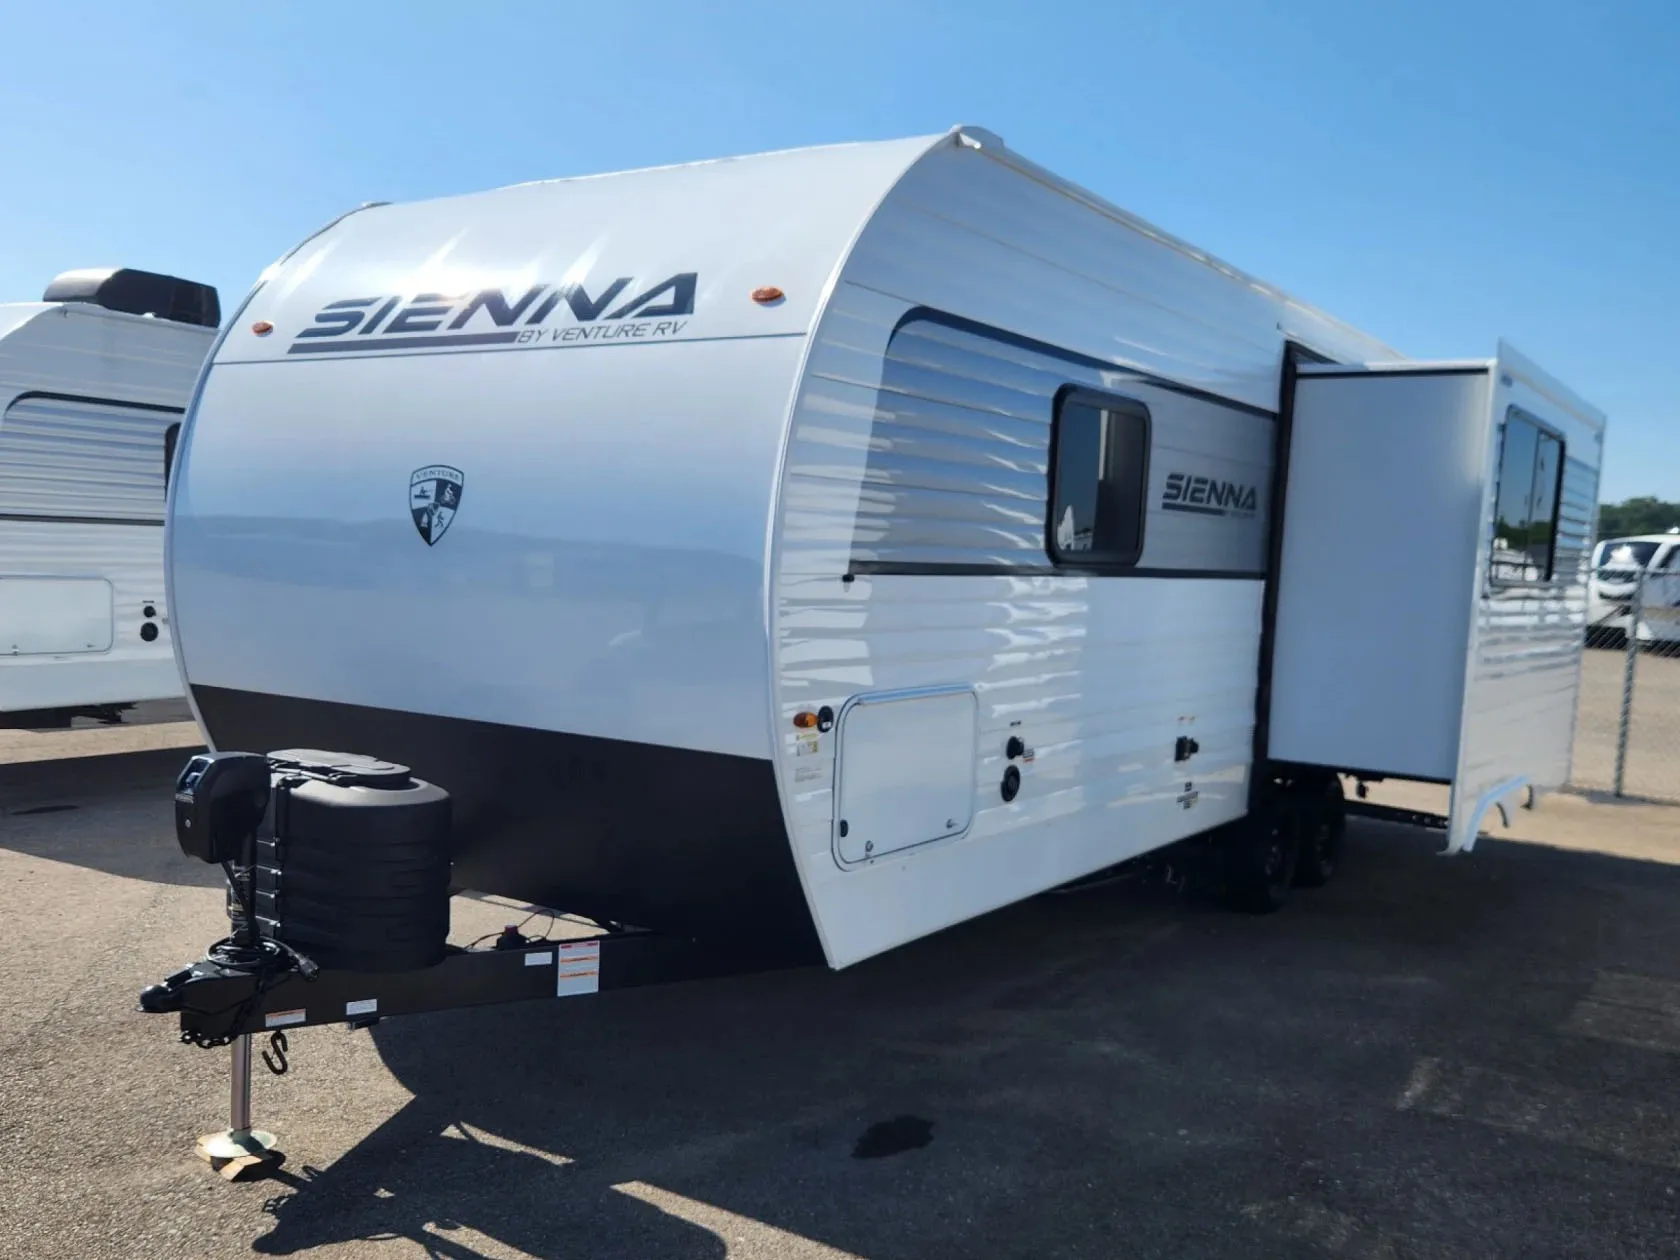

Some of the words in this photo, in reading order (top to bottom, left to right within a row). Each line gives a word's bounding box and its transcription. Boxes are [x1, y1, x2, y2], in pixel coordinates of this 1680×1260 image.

[295, 272, 698, 339] SIENNA
[517, 329, 548, 344] BY
[551, 323, 652, 342] VENTURE
[652, 320, 688, 336] RV
[1162, 472, 1257, 511] SIENNA
